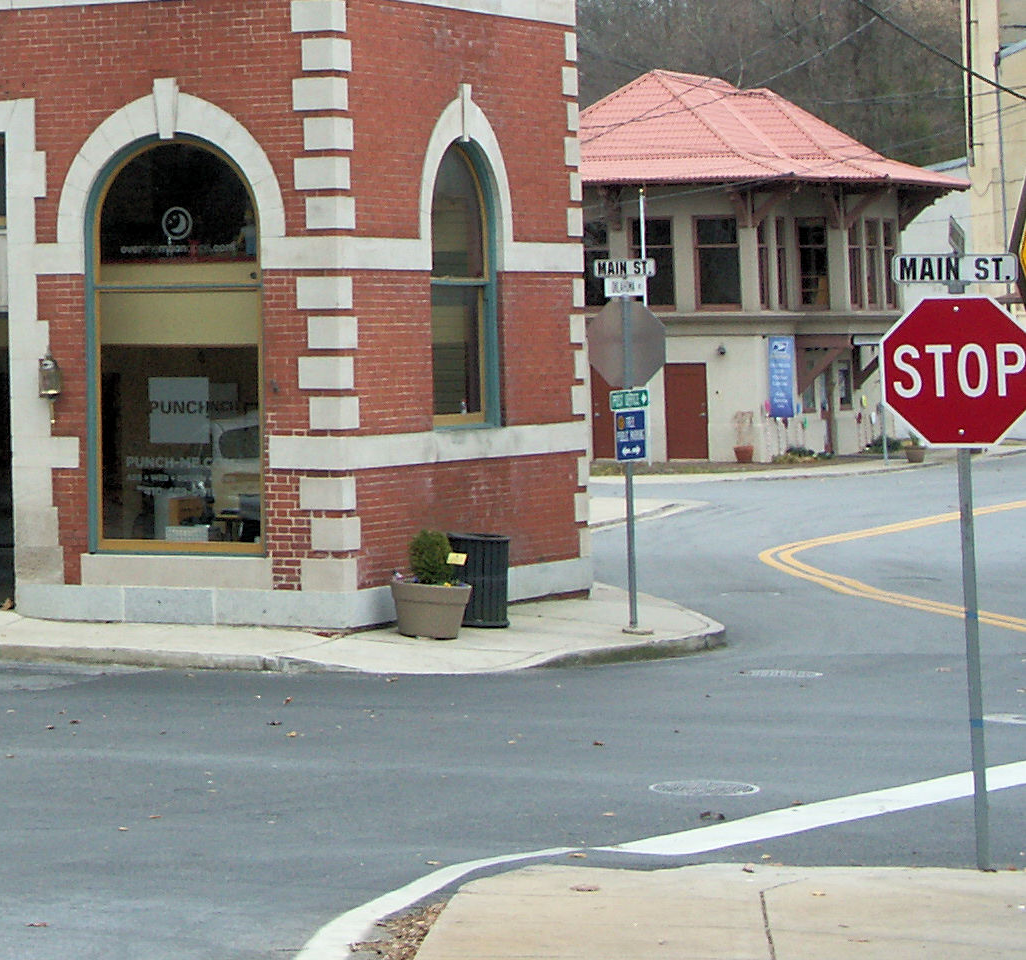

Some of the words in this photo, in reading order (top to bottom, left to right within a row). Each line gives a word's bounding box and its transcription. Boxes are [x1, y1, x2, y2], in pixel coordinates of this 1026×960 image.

[598, 261, 627, 274] MAIN
[634, 260, 652, 274] ST.
[899, 257, 959, 280] MAIN
[974, 257, 1011, 280] ST.
[893, 343, 1026, 399] STOP
[150, 400, 209, 414] PUNCH
